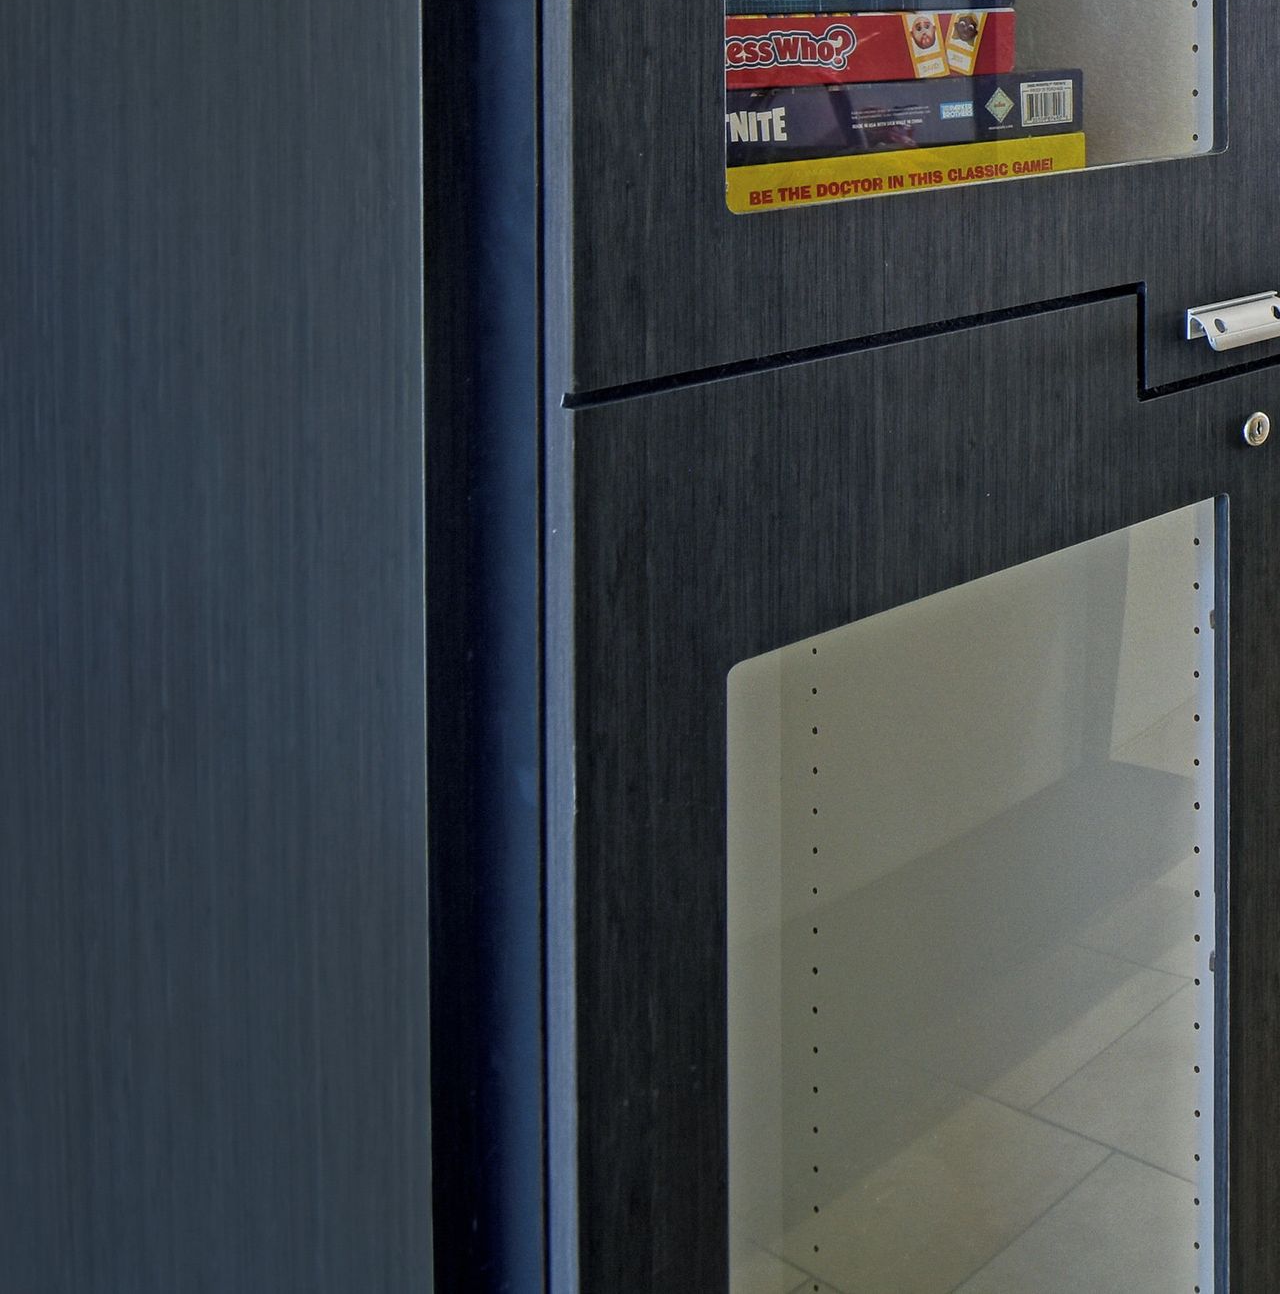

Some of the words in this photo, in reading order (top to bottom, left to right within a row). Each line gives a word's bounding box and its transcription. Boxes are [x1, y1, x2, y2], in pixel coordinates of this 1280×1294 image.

[725, 40, 773, 65] ess
[772, 30, 851, 66] Who?
[725, 107, 788, 143] NITE
[750, 190, 773, 205] BE
[778, 186, 812, 202] THE
[816, 177, 883, 197] DOCTOR
[888, 175, 904, 189] IN
[908, 170, 944, 186] THIS
[948, 163, 1009, 182] CLASSIC
[1012, 158, 1054, 174] GAME!
